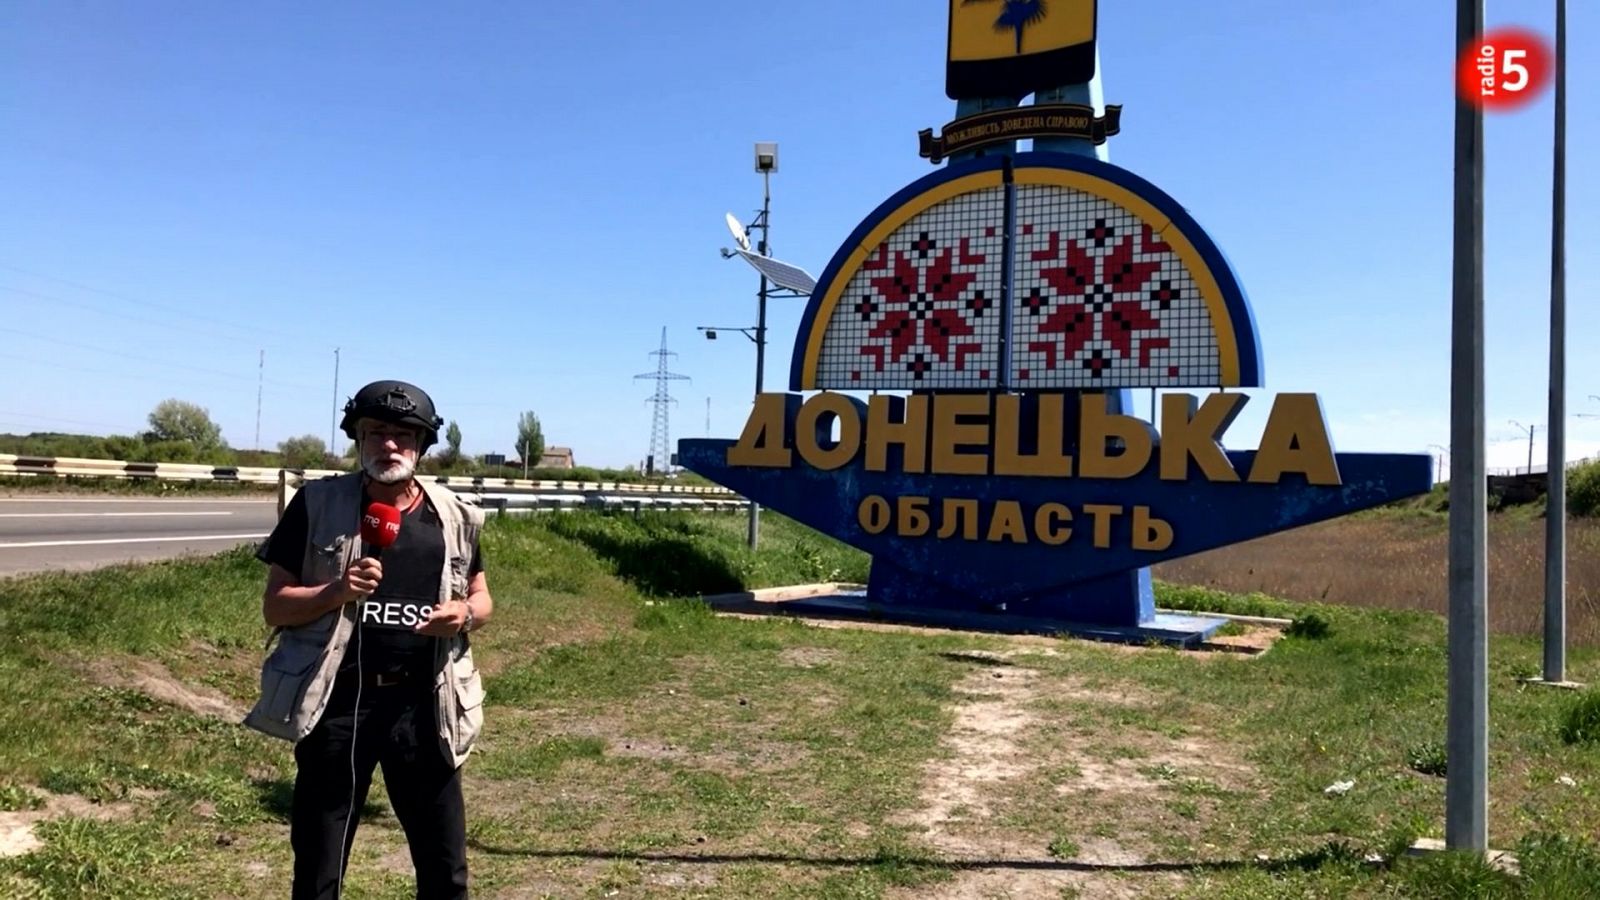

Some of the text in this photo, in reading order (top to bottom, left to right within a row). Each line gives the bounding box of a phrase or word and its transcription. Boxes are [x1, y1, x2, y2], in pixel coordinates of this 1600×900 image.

[1000, 116, 1045, 134] ДОВЕДЕНА
[1046, 115, 1089, 130] СПРАВОЮ
[726, 392, 1342, 486] ДОНЕЦЬКА
[857, 493, 1175, 552] ОБЛАСТЬ
[362, 601, 433, 626] RESS
